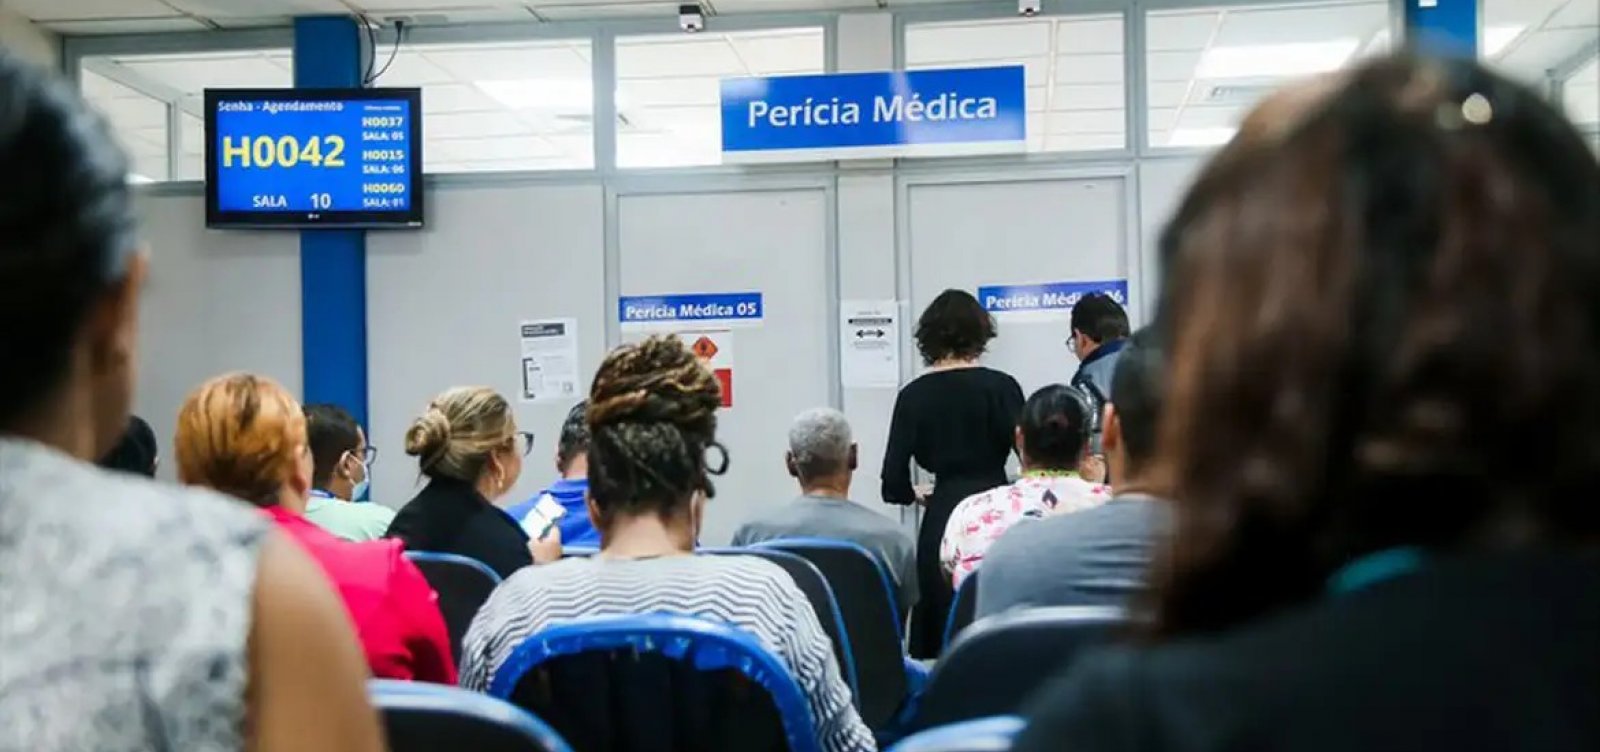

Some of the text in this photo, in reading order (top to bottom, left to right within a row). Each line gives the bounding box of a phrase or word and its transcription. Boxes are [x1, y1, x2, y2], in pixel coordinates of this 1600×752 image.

[218, 101, 253, 112] Senha
[262, 101, 344, 115] Agendamento
[748, 91, 998, 128] Perícia Médica
[362, 116, 403, 127] H0037
[222, 134, 346, 168] H0042
[362, 150, 405, 161] H0015
[363, 183, 405, 193] H0060
[252, 193, 331, 209] SALA 10
[625, 302, 757, 319] Perícia Médica 05
